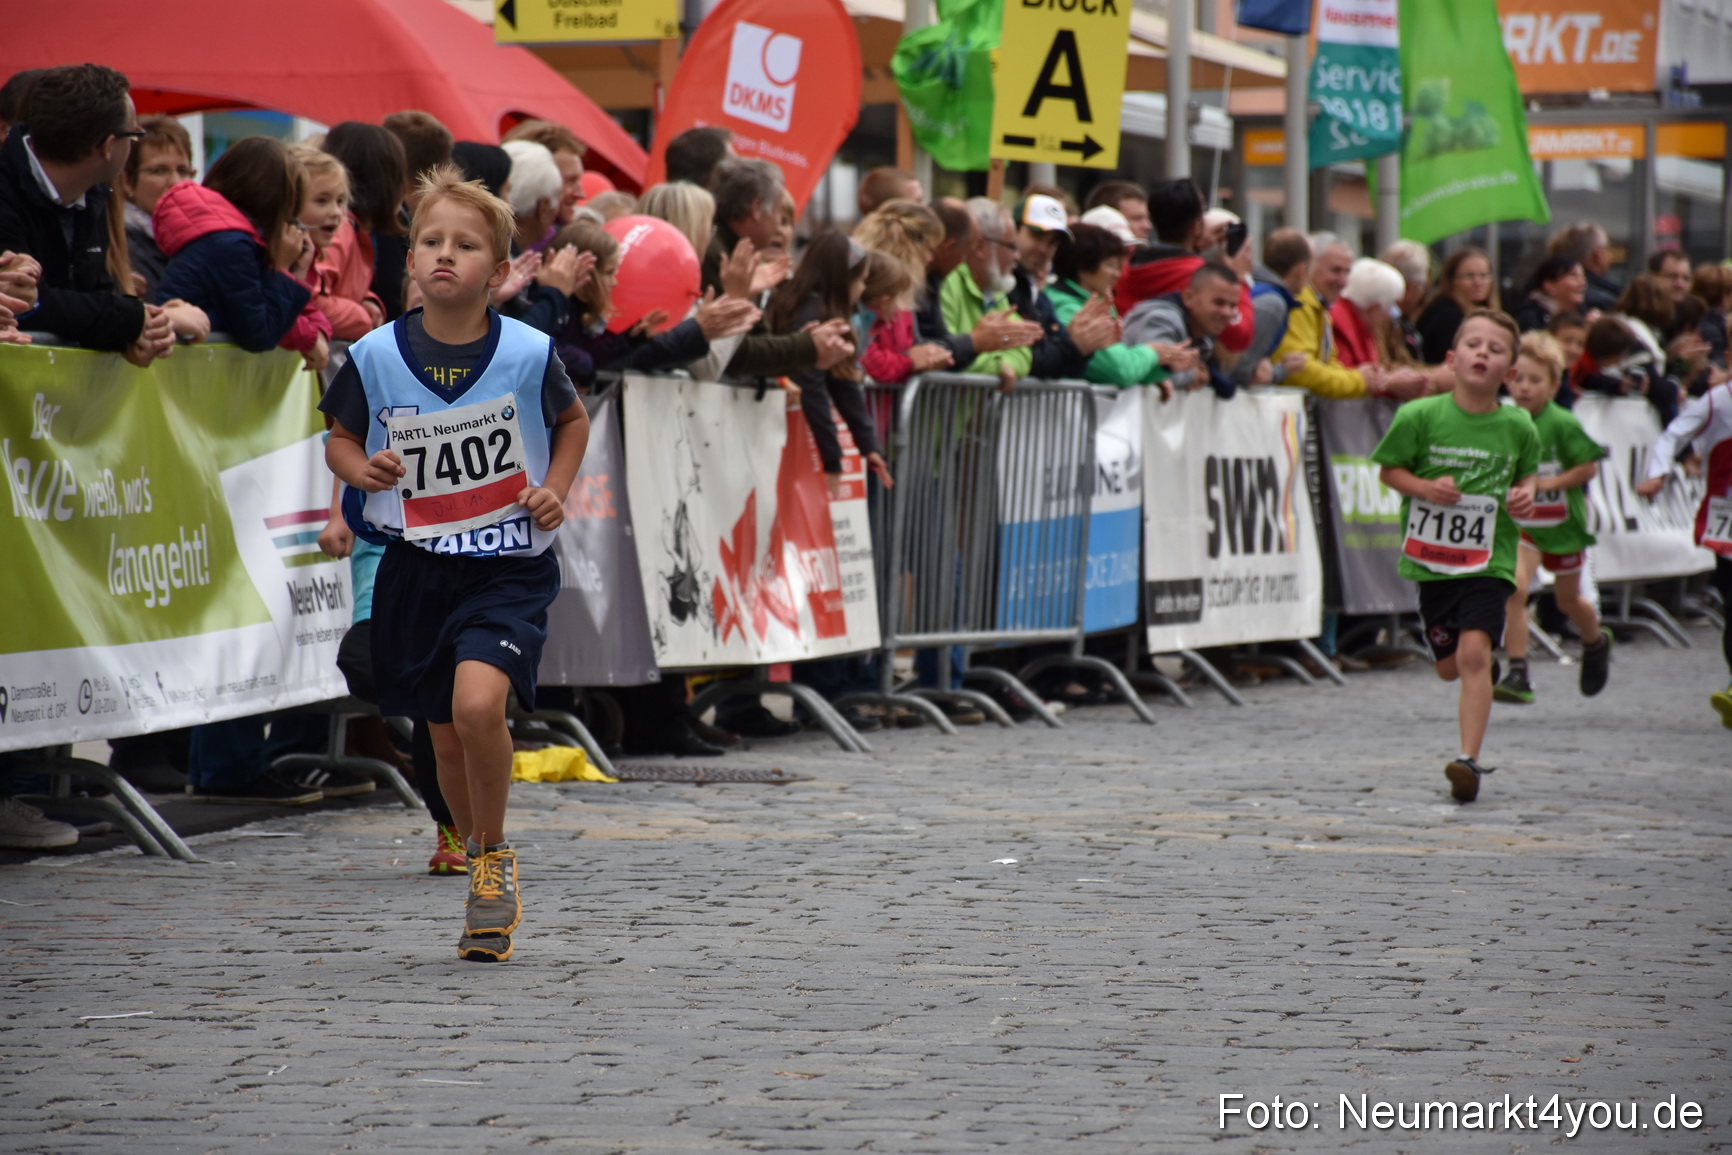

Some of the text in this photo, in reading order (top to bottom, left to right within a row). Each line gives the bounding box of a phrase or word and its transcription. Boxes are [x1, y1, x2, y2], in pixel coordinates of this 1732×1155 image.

[554, 11, 618, 29] Freibad
[1500, 13, 1643, 65] RKT.DE
[1021, 29, 1094, 124] A
[729, 82, 787, 121] DKMS
[30, 392, 62, 440] Der
[391, 412, 498, 442] PARTL Neumarkt
[403, 428, 516, 491] 7402
[82, 465, 153, 521] weiß, wo's
[1417, 506, 1486, 545] 7184
[107, 523, 211, 609] langgeht!
[1421, 546, 1469, 564] Dominik
